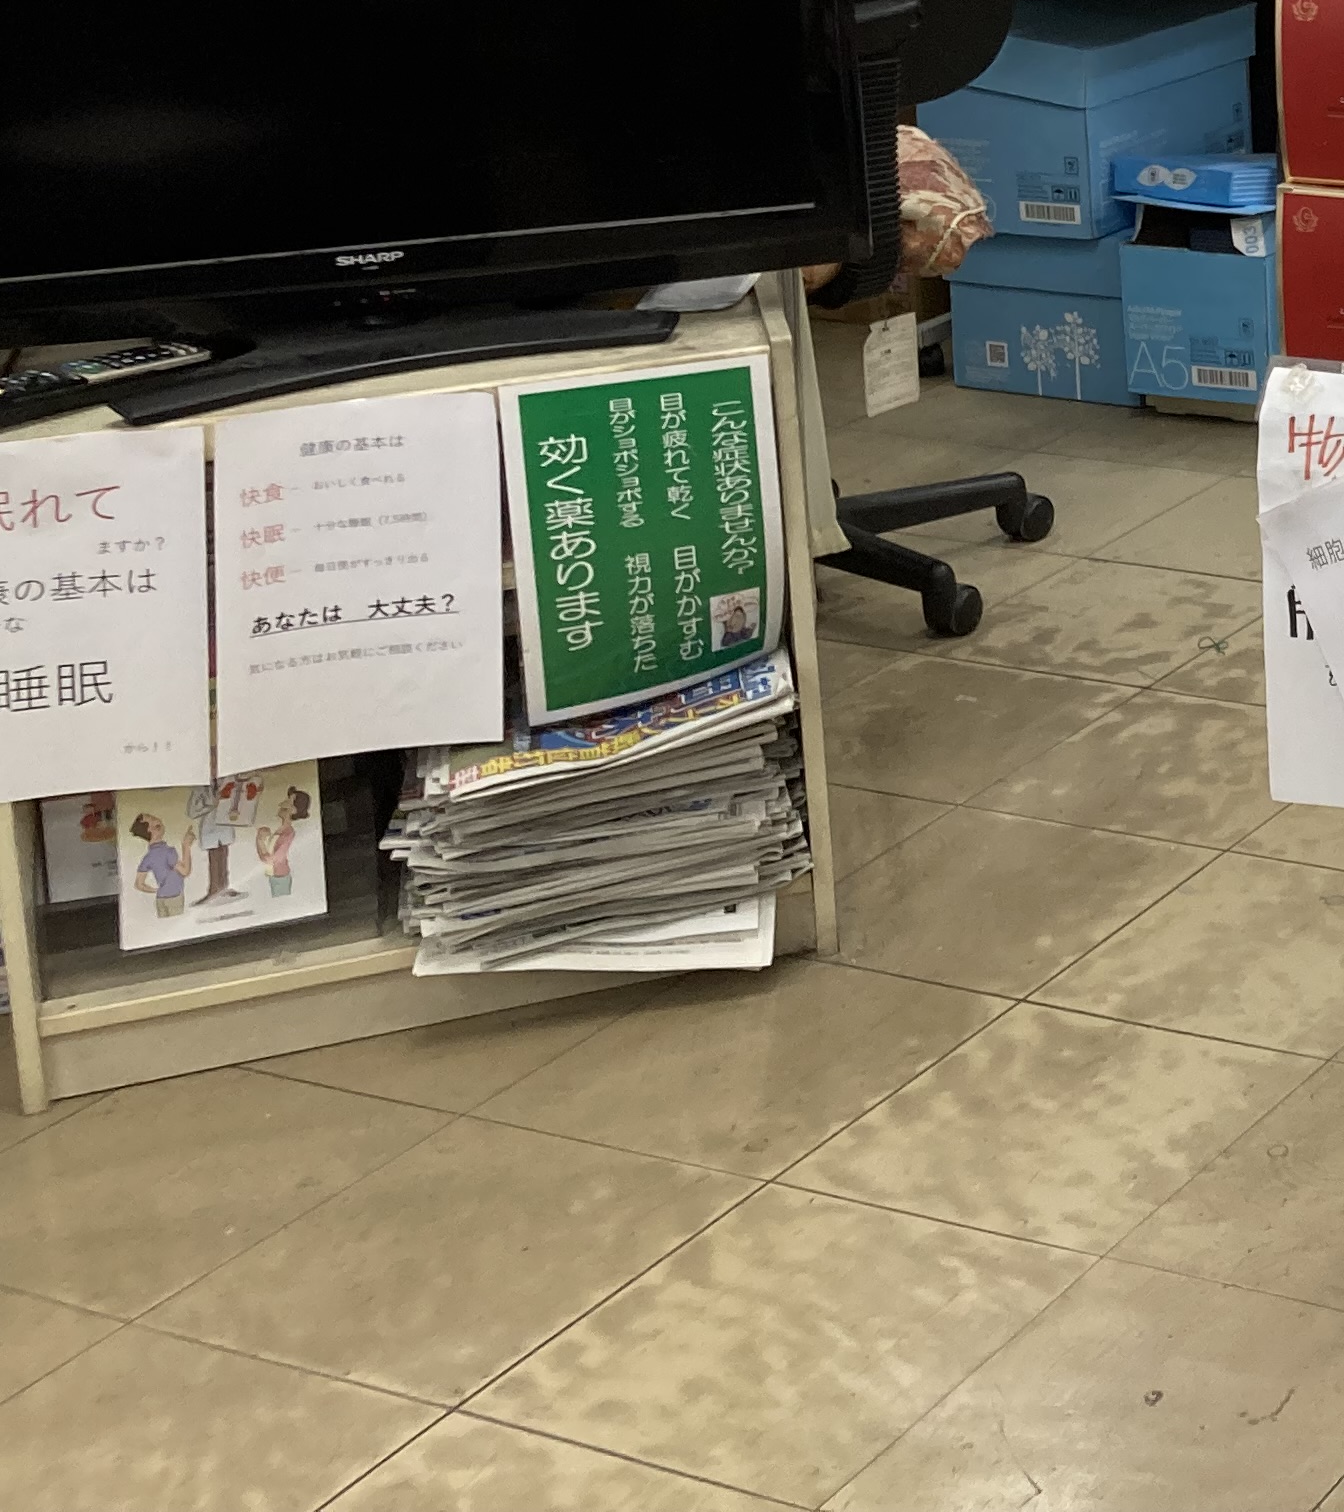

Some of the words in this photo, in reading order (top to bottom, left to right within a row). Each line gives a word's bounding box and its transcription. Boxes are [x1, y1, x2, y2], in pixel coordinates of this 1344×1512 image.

[334, 249, 405, 267] SHARP
[300, 435, 405, 458] 健康の基本は
[608, 396, 645, 529] 目がショボショボする
[659, 391, 693, 521] 目が疲れて乾く
[240, 482, 285, 508] 快食
[240, 523, 286, 549] 快眠
[538, 433, 605, 652] 効く薬あります
[241, 564, 287, 590] 快便
[251, 603, 343, 635] あなたは
[624, 552, 659, 674] 視力が落ちた
[673, 545, 704, 661] 目がかすむ
